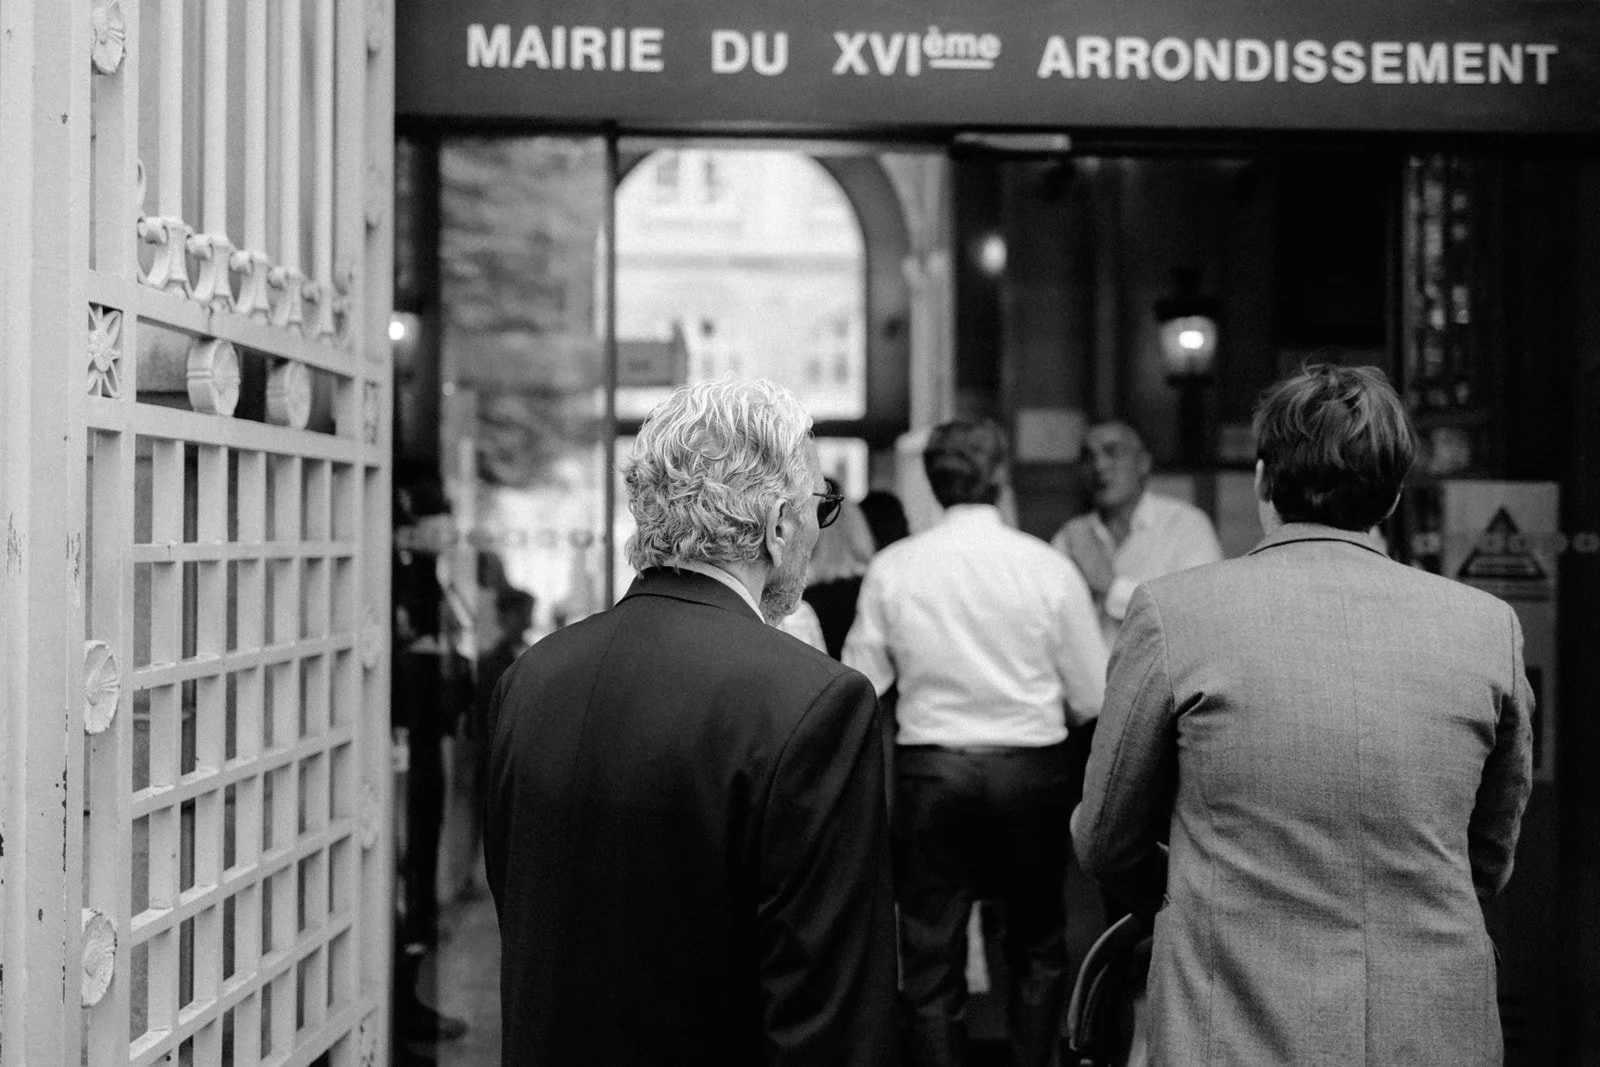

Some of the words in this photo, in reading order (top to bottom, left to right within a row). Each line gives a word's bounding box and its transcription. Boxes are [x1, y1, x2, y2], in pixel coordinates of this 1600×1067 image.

[466, 23, 664, 72] MAIRIE
[711, 29, 789, 76] DU
[832, 24, 1002, 78] XVIème
[1037, 34, 1559, 85] ARRONDISSEMENT
